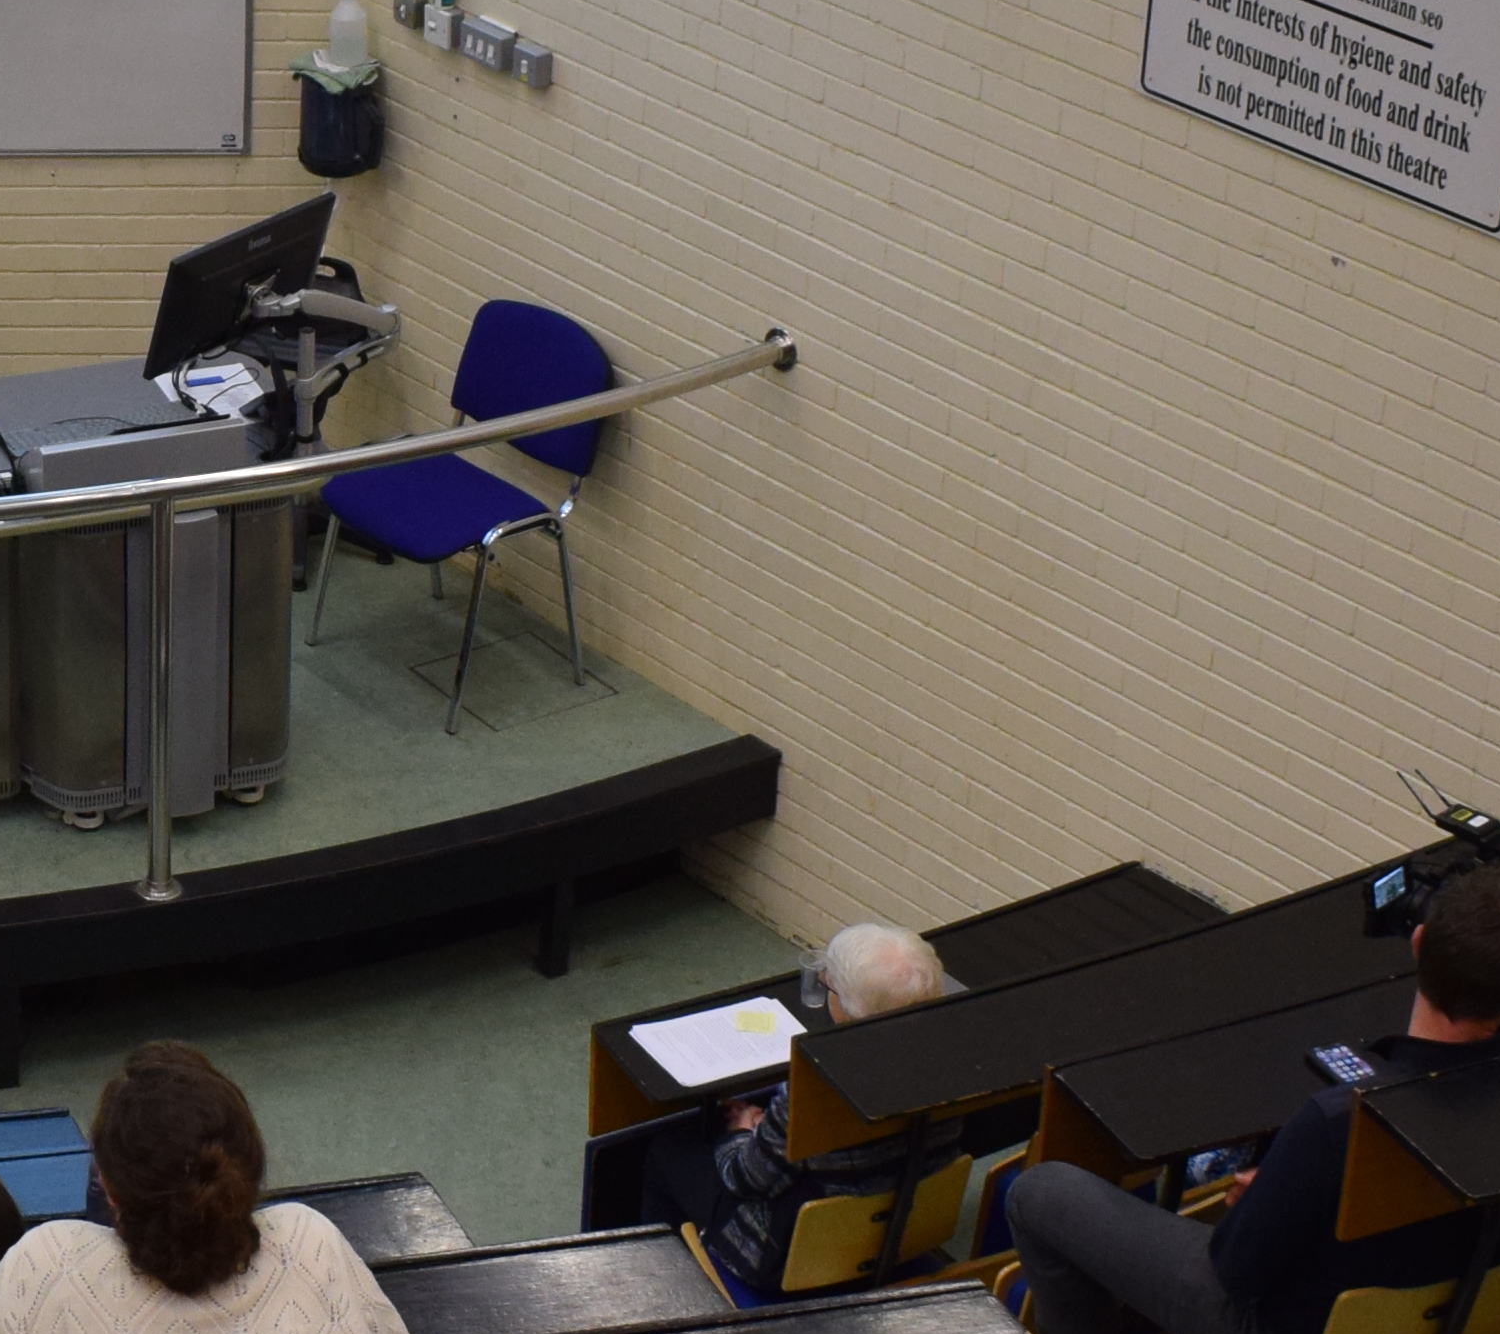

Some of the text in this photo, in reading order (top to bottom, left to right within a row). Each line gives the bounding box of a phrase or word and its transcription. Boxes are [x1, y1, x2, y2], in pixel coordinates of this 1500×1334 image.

[1308, 19, 1330, 50] of
[1329, 23, 1395, 76] hygiene
[1397, 58, 1433, 90] and
[1433, 70, 1487, 118] safety
[1419, 8, 1444, 31] seo
[1185, 16, 1471, 154] the consumption of food and drink
[1196, 63, 1448, 190] is not permitted in this theatre
